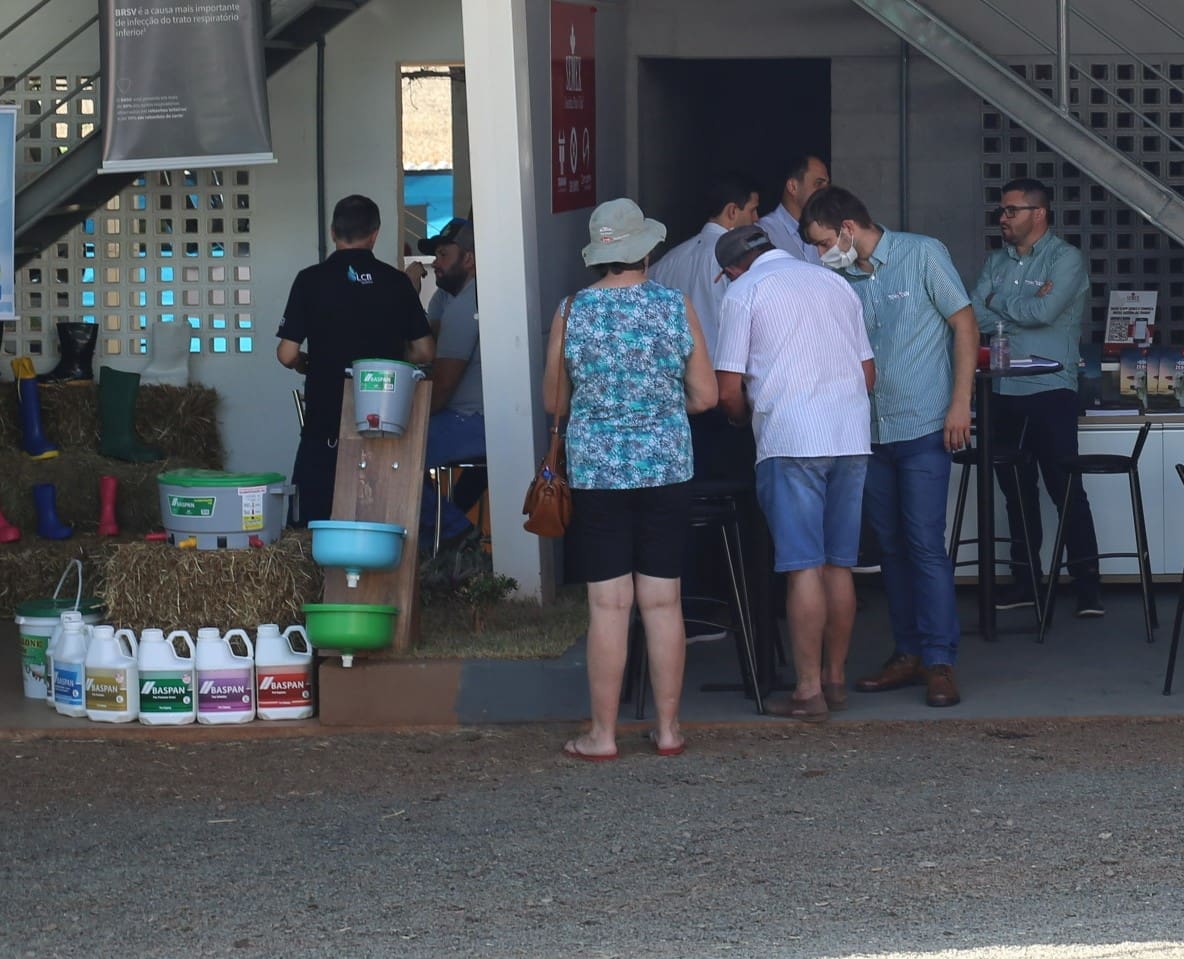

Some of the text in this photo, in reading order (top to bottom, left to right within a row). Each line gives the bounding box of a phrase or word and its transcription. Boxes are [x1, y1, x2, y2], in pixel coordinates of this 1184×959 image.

[115, 3, 240, 17] BRSV é a causa mais importante
[115, 13, 239, 28] de infecção do trato respiratório
[92, 682, 118, 693] BASPAN
[210, 685, 244, 695] BASPAN
[271, 680, 304, 690] BASPAN
[152, 686, 185, 695] BASPAN
